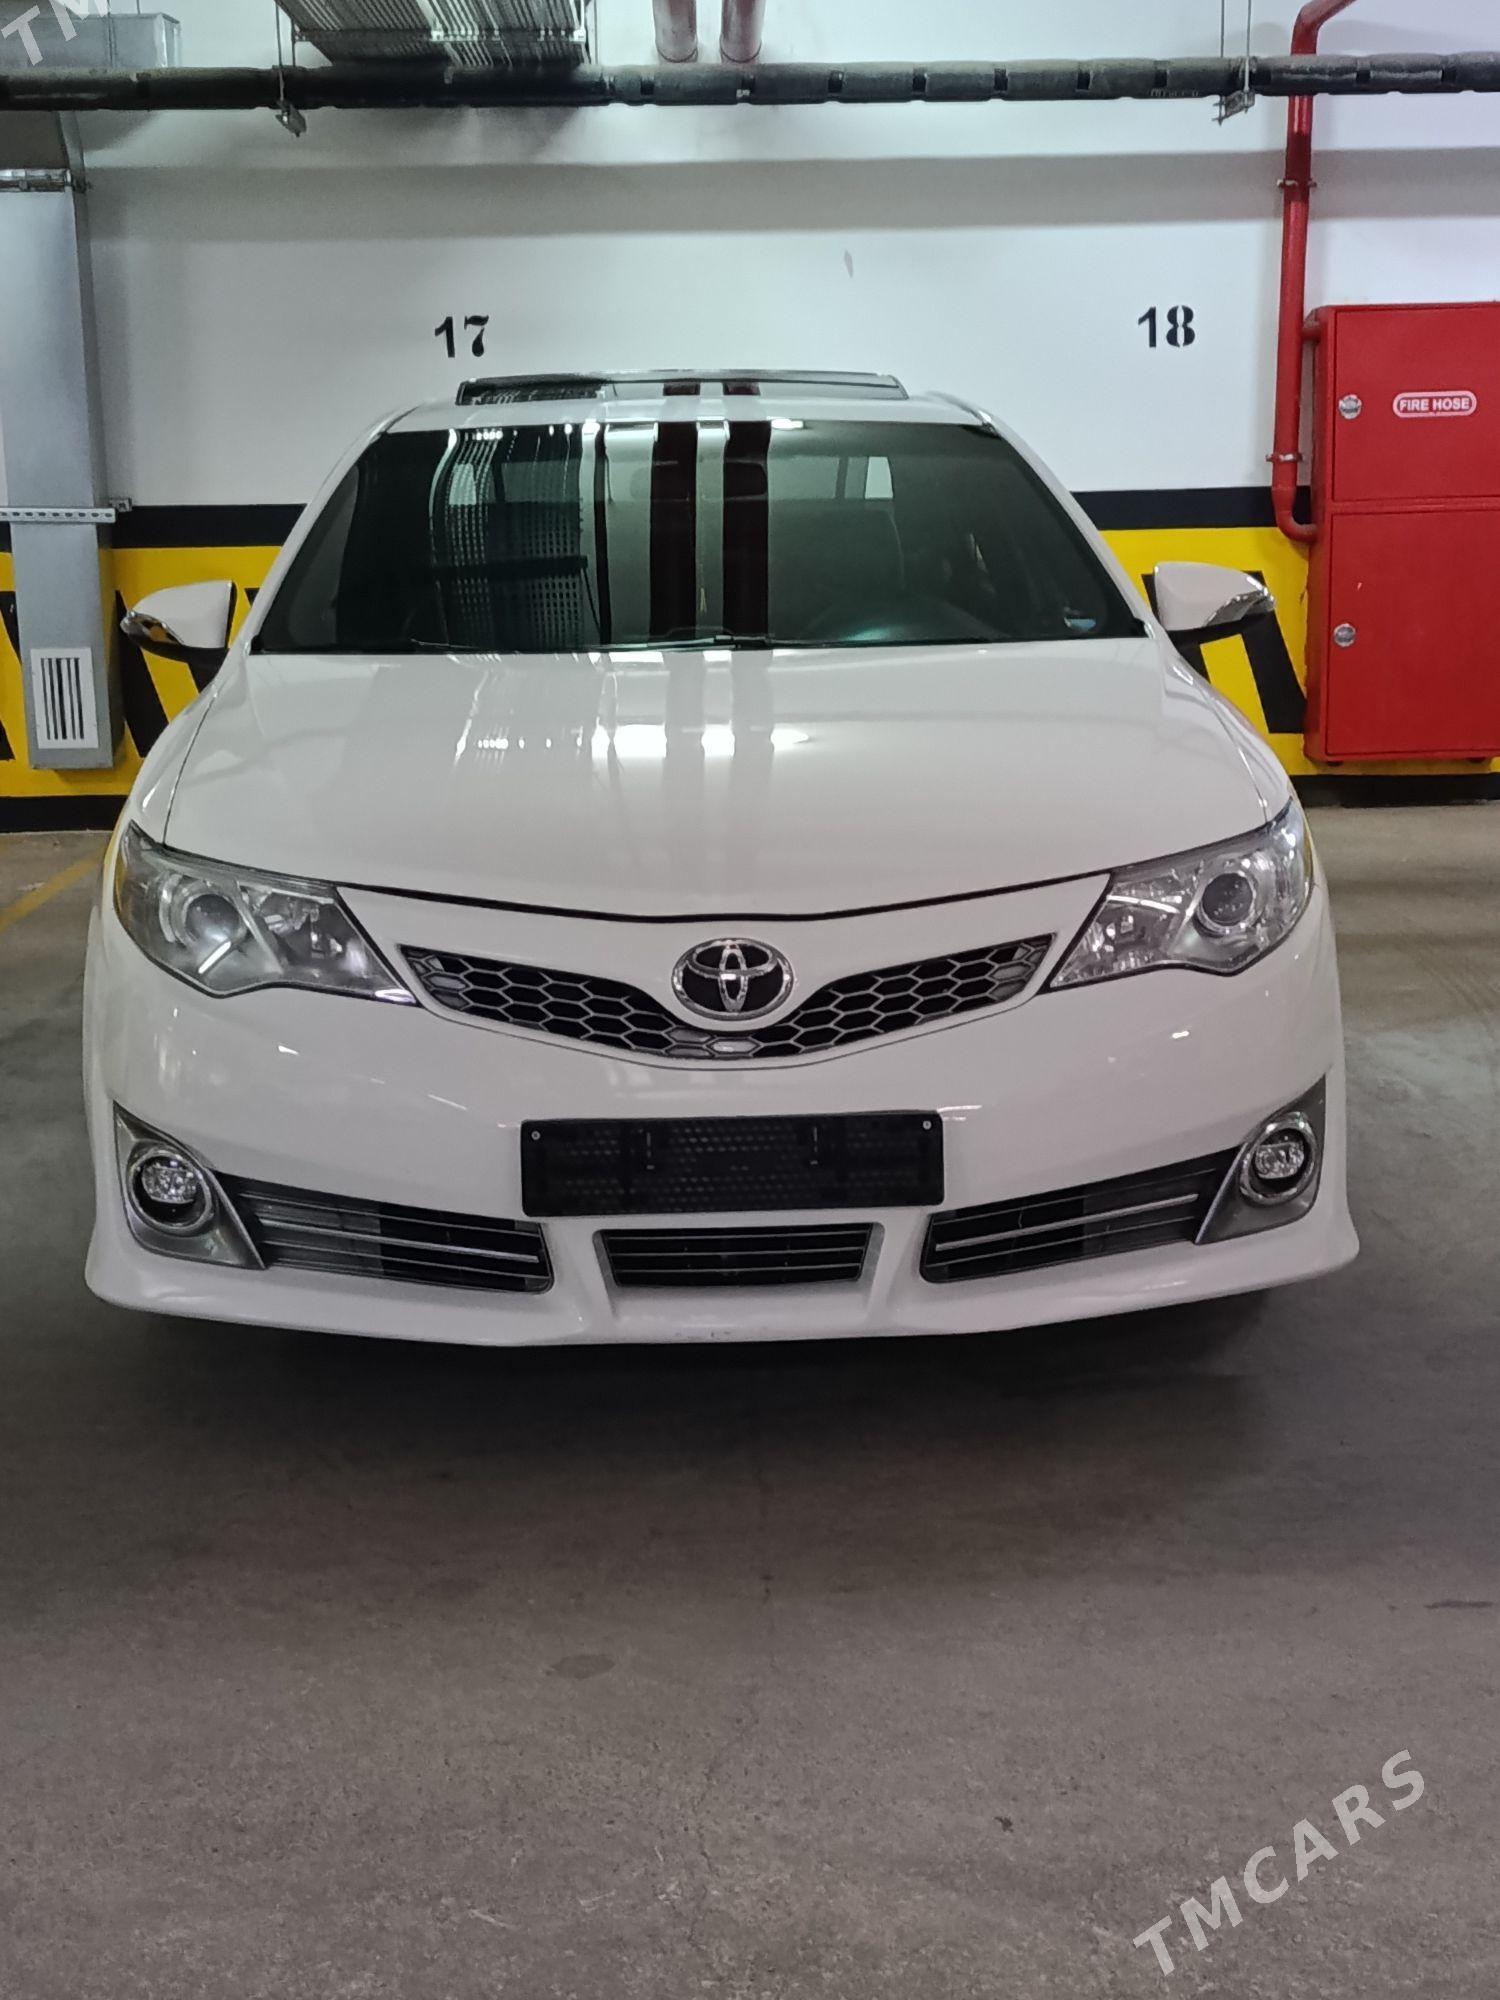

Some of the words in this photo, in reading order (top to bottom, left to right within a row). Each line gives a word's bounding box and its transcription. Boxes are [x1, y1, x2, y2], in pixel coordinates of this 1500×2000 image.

[434, 314, 489, 358] 17
[1137, 304, 1196, 348] 18
[1399, 399, 1429, 412] FIRE
[1432, 397, 1470, 411] HOSE
